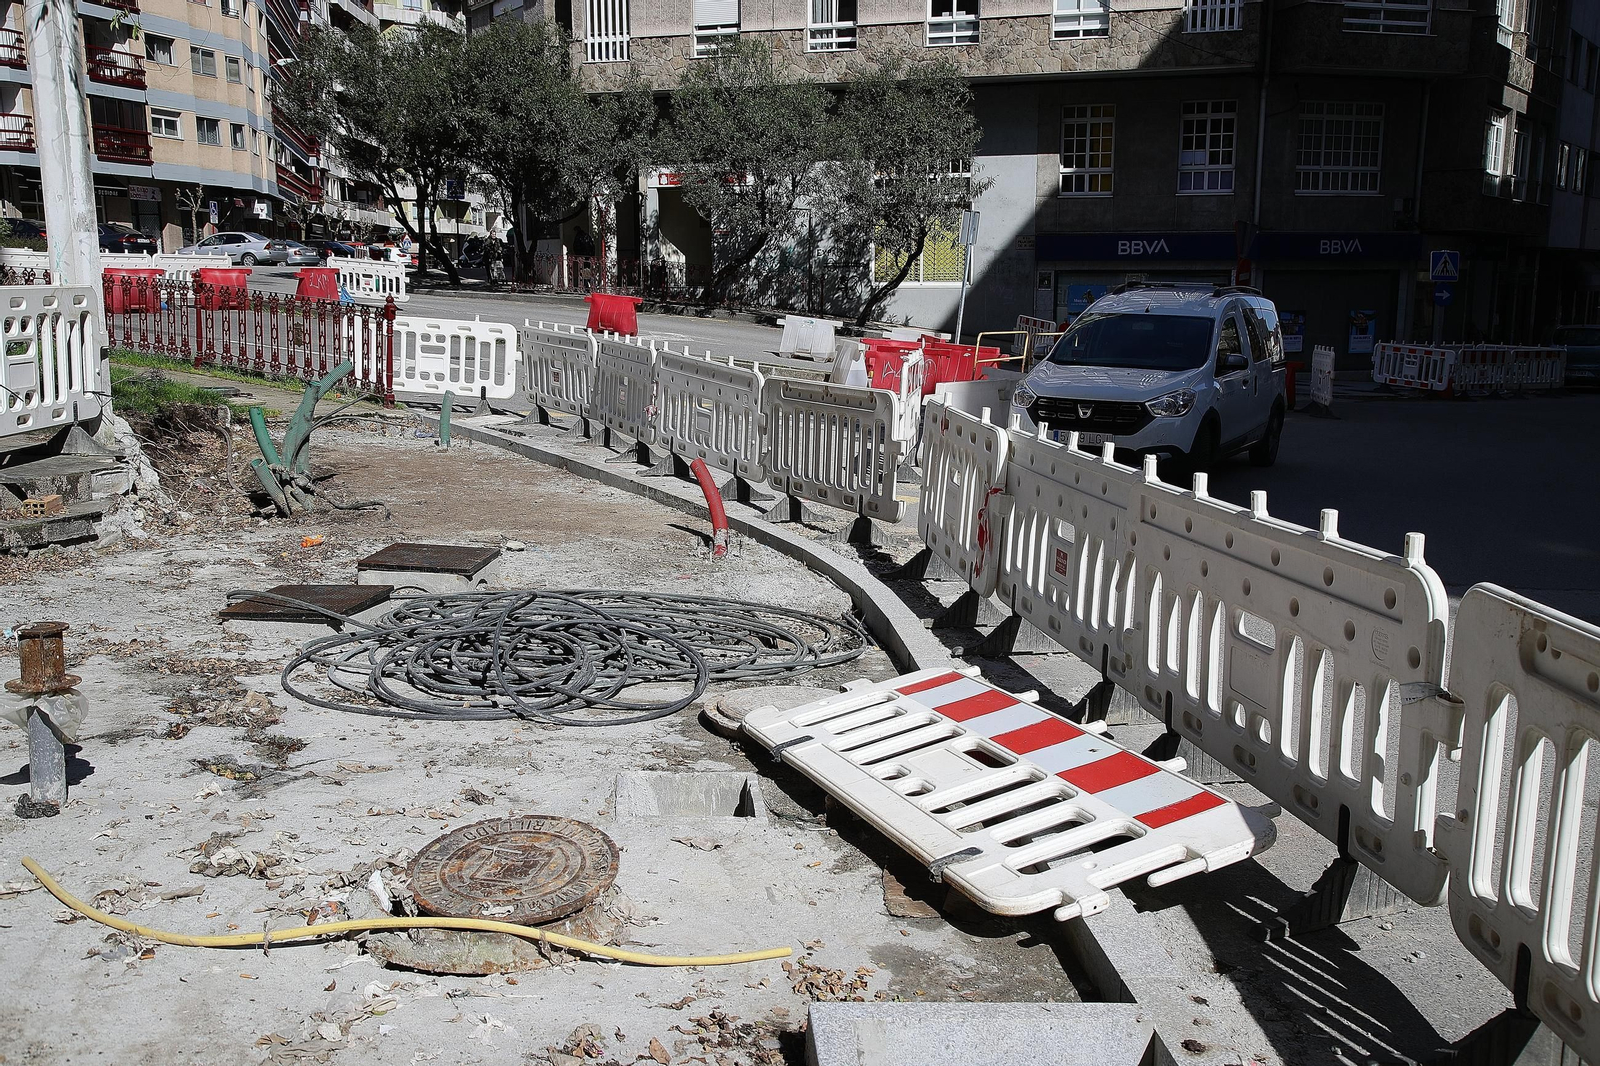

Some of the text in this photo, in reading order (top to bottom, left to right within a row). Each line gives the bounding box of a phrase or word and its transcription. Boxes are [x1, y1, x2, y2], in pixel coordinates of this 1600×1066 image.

[1117, 238, 1170, 256] BBVA
[1318, 238, 1363, 255] BBVA
[1060, 431, 1085, 444] 59
